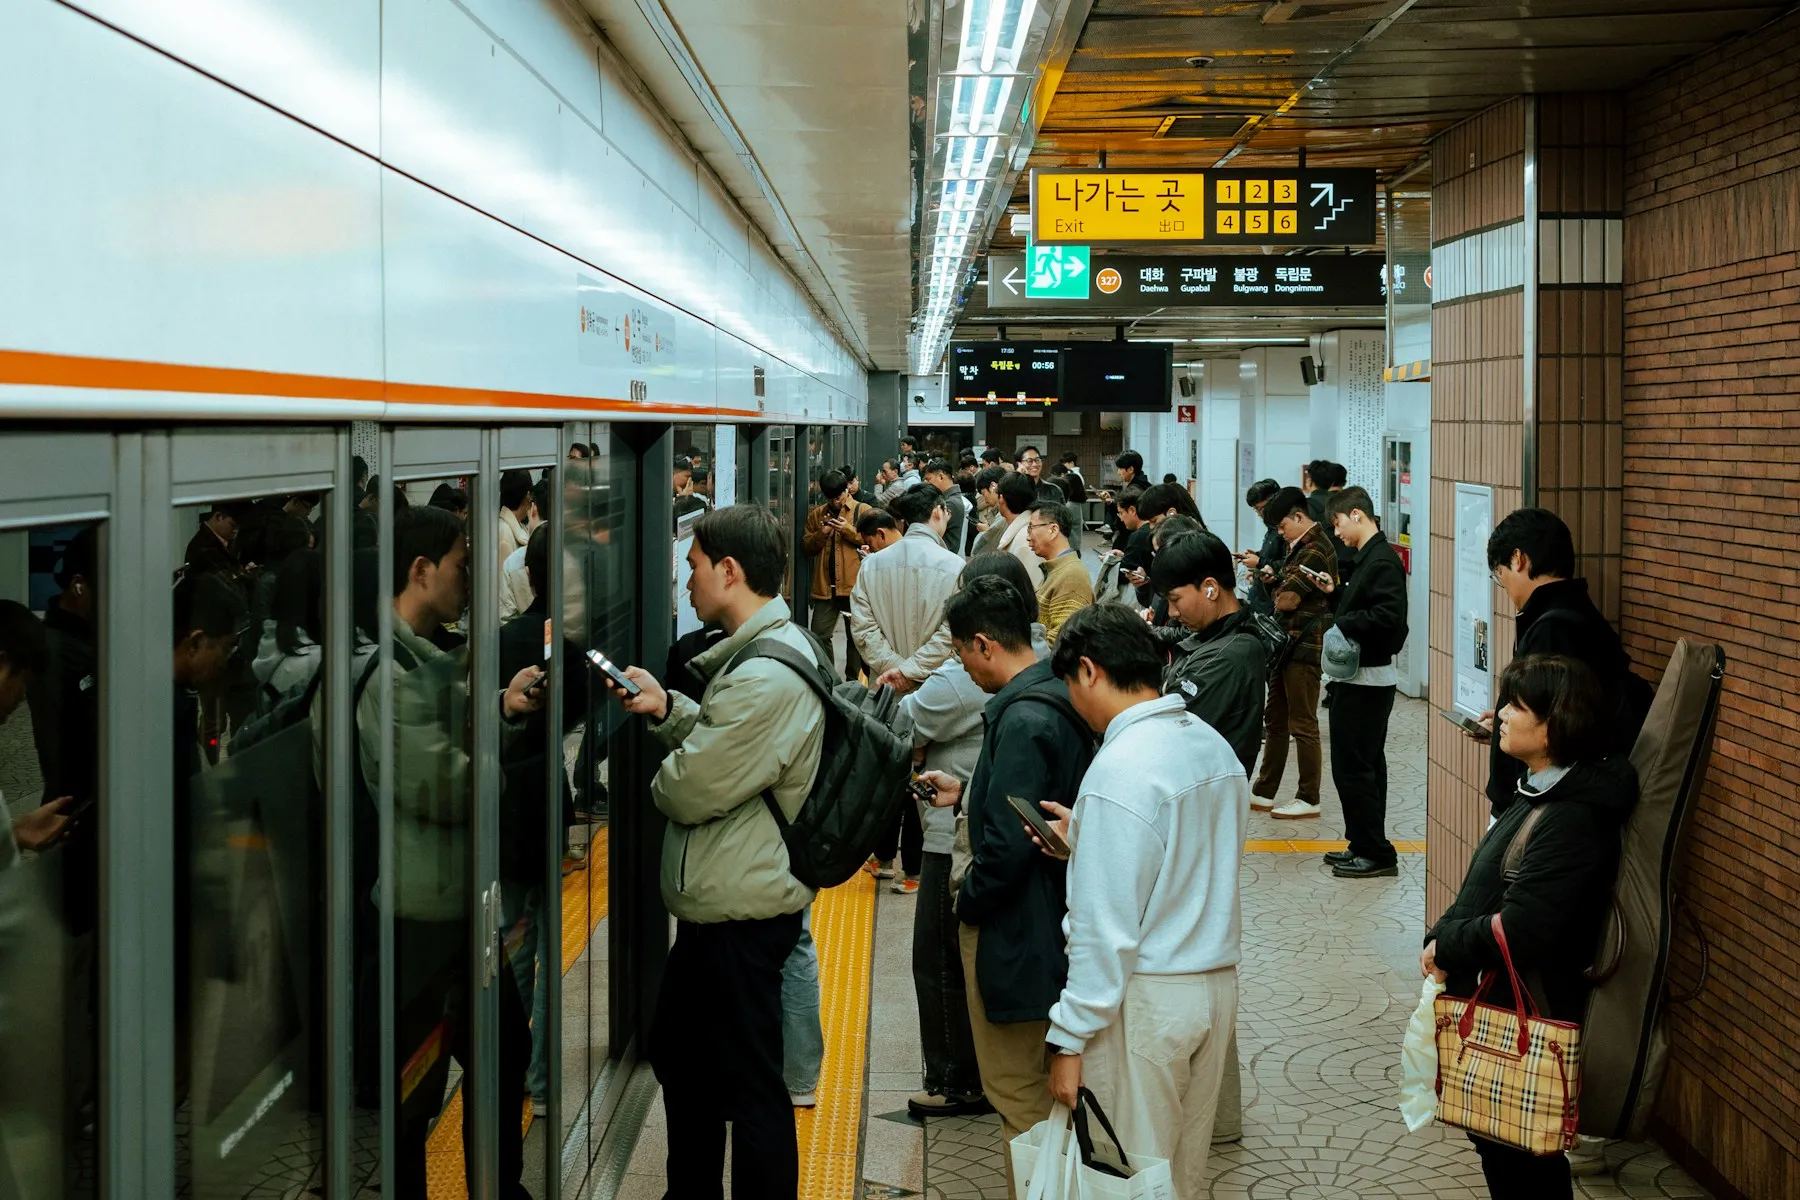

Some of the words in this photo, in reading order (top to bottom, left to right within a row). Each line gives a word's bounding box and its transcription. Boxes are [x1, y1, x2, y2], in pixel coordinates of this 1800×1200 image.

[1055, 178, 1145, 212] 나가는
[1156, 179, 1185, 212] 곳
[1225, 185, 1231, 199] 1
[1252, 184, 1262, 199] 2
[1281, 184, 1291, 199] 3
[1055, 218, 1085, 233] Exit
[1159, 219, 1185, 233] 出口
[1223, 215, 1233, 229] 4
[1252, 215, 1262, 229] 5
[1280, 215, 1291, 229] 6
[1100, 276, 1118, 286] 327
[1139, 267, 1165, 283] 대화
[1180, 267, 1217, 283] 구파발
[1233, 267, 1259, 283] 불광
[1275, 267, 1312, 283] 독립문
[1140, 284, 1169, 293] Daehwa
[1180, 284, 1210, 294] Gupabal
[1233, 284, 1269, 294] Bulgwang
[1275, 284, 1324, 294] Dongnimmun
[1031, 361, 1055, 370] 00:56
